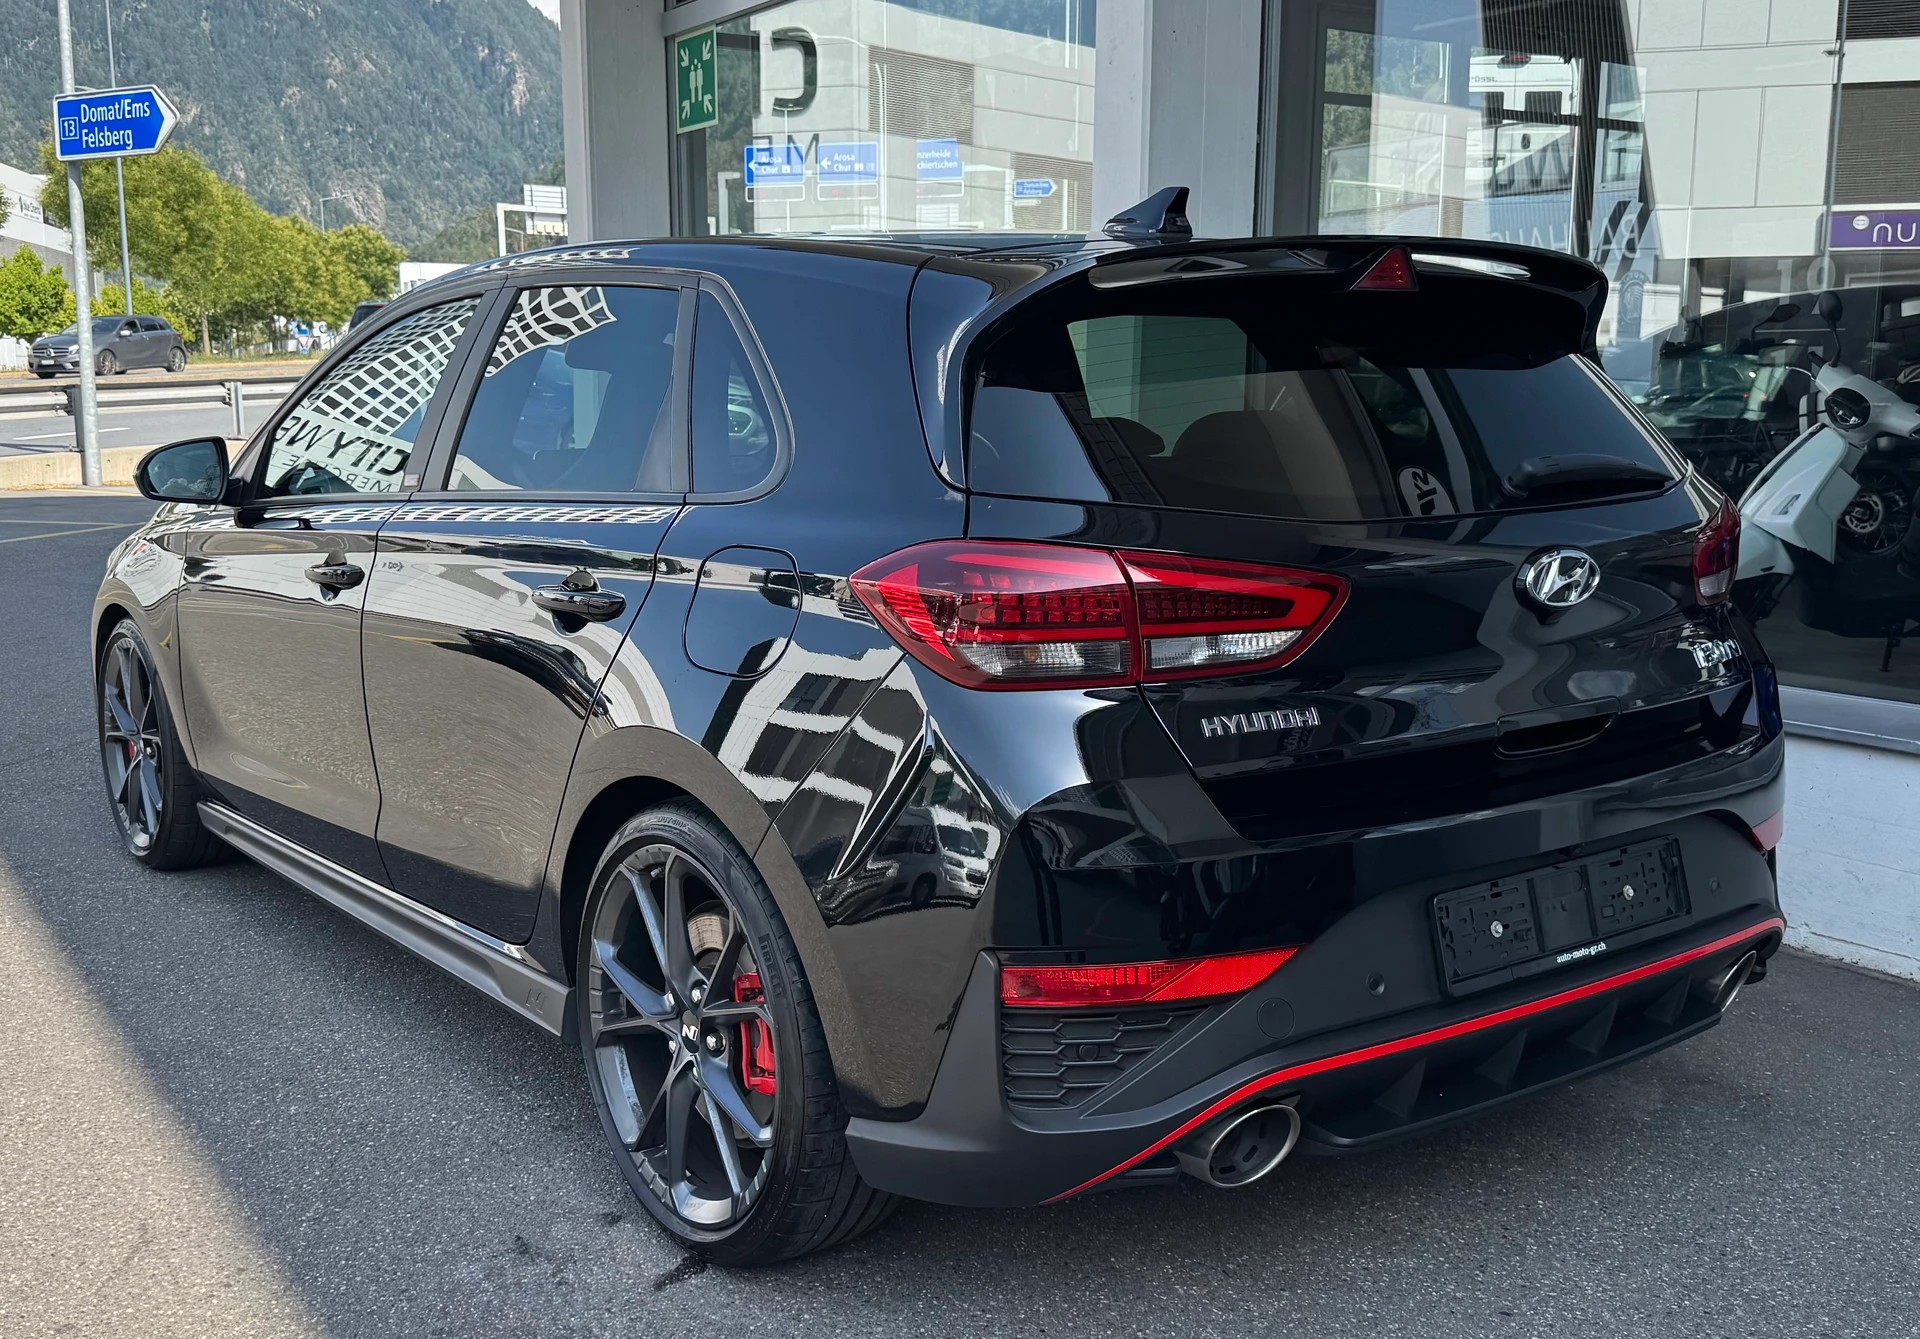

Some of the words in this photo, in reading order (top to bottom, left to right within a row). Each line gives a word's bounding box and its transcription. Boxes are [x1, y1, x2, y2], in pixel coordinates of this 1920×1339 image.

[81, 99, 151, 123] Domat/Ems
[63, 120, 76, 137] 13
[82, 126, 133, 150] Felsberg
[833, 153, 856, 162] Arosa
[833, 163, 852, 172] Chur
[1200, 706, 1321, 738] HYUNDAI
[1556, 941, 1607, 963] auto-moto-gr.ch
